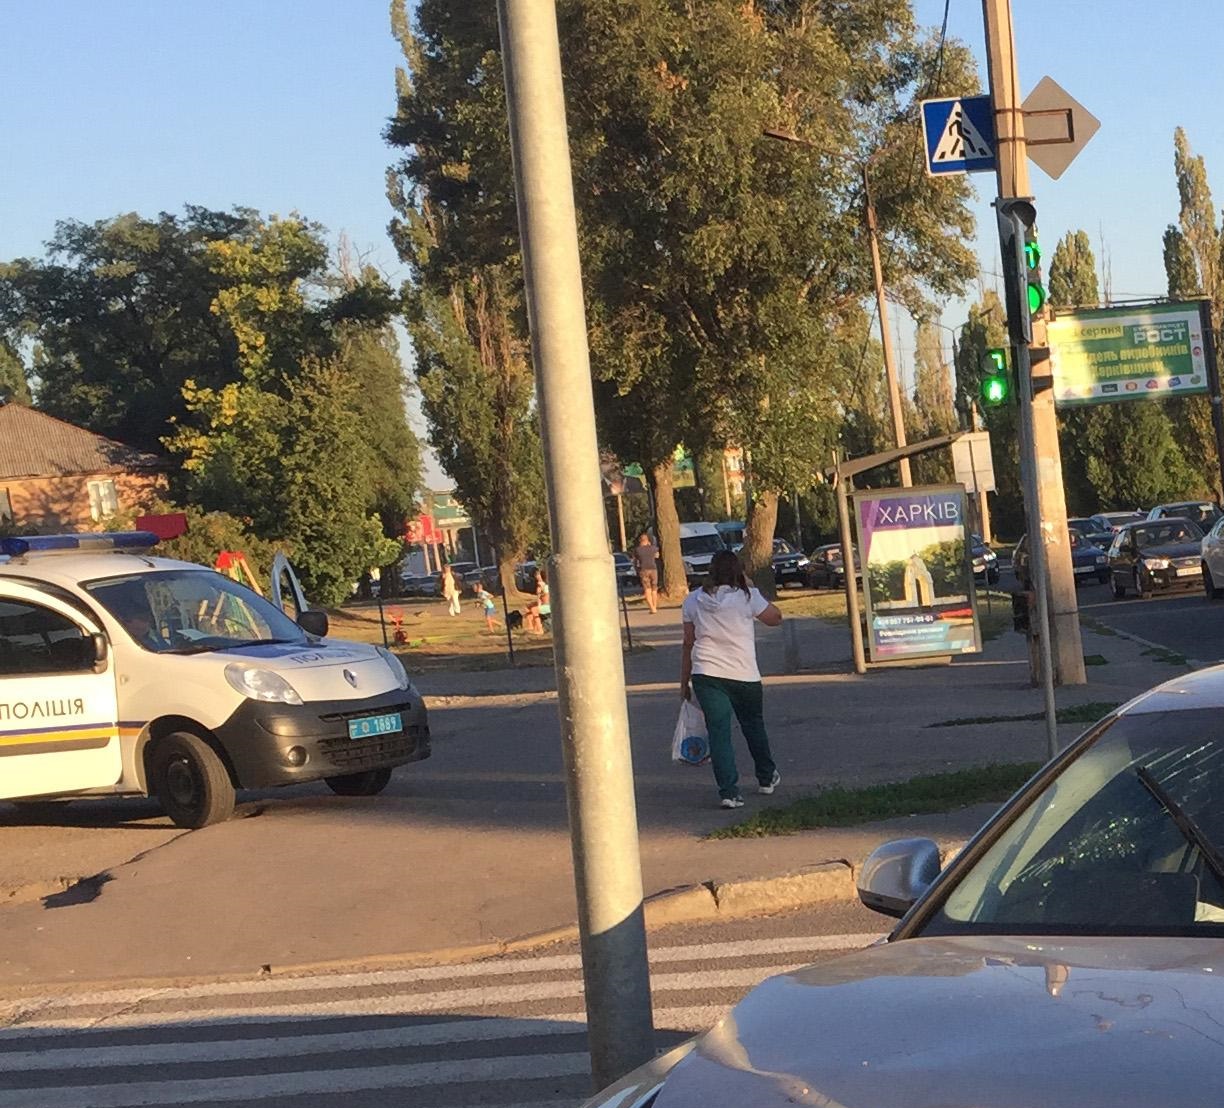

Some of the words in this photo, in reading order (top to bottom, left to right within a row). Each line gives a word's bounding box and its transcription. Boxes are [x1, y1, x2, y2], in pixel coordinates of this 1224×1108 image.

[1081, 325, 1121, 337] серпня
[1133, 328, 1186, 344] РОСТ
[879, 501, 959, 524] ХАРКІВ
[0, 698, 84, 719] ПОЛІЦІЯ
